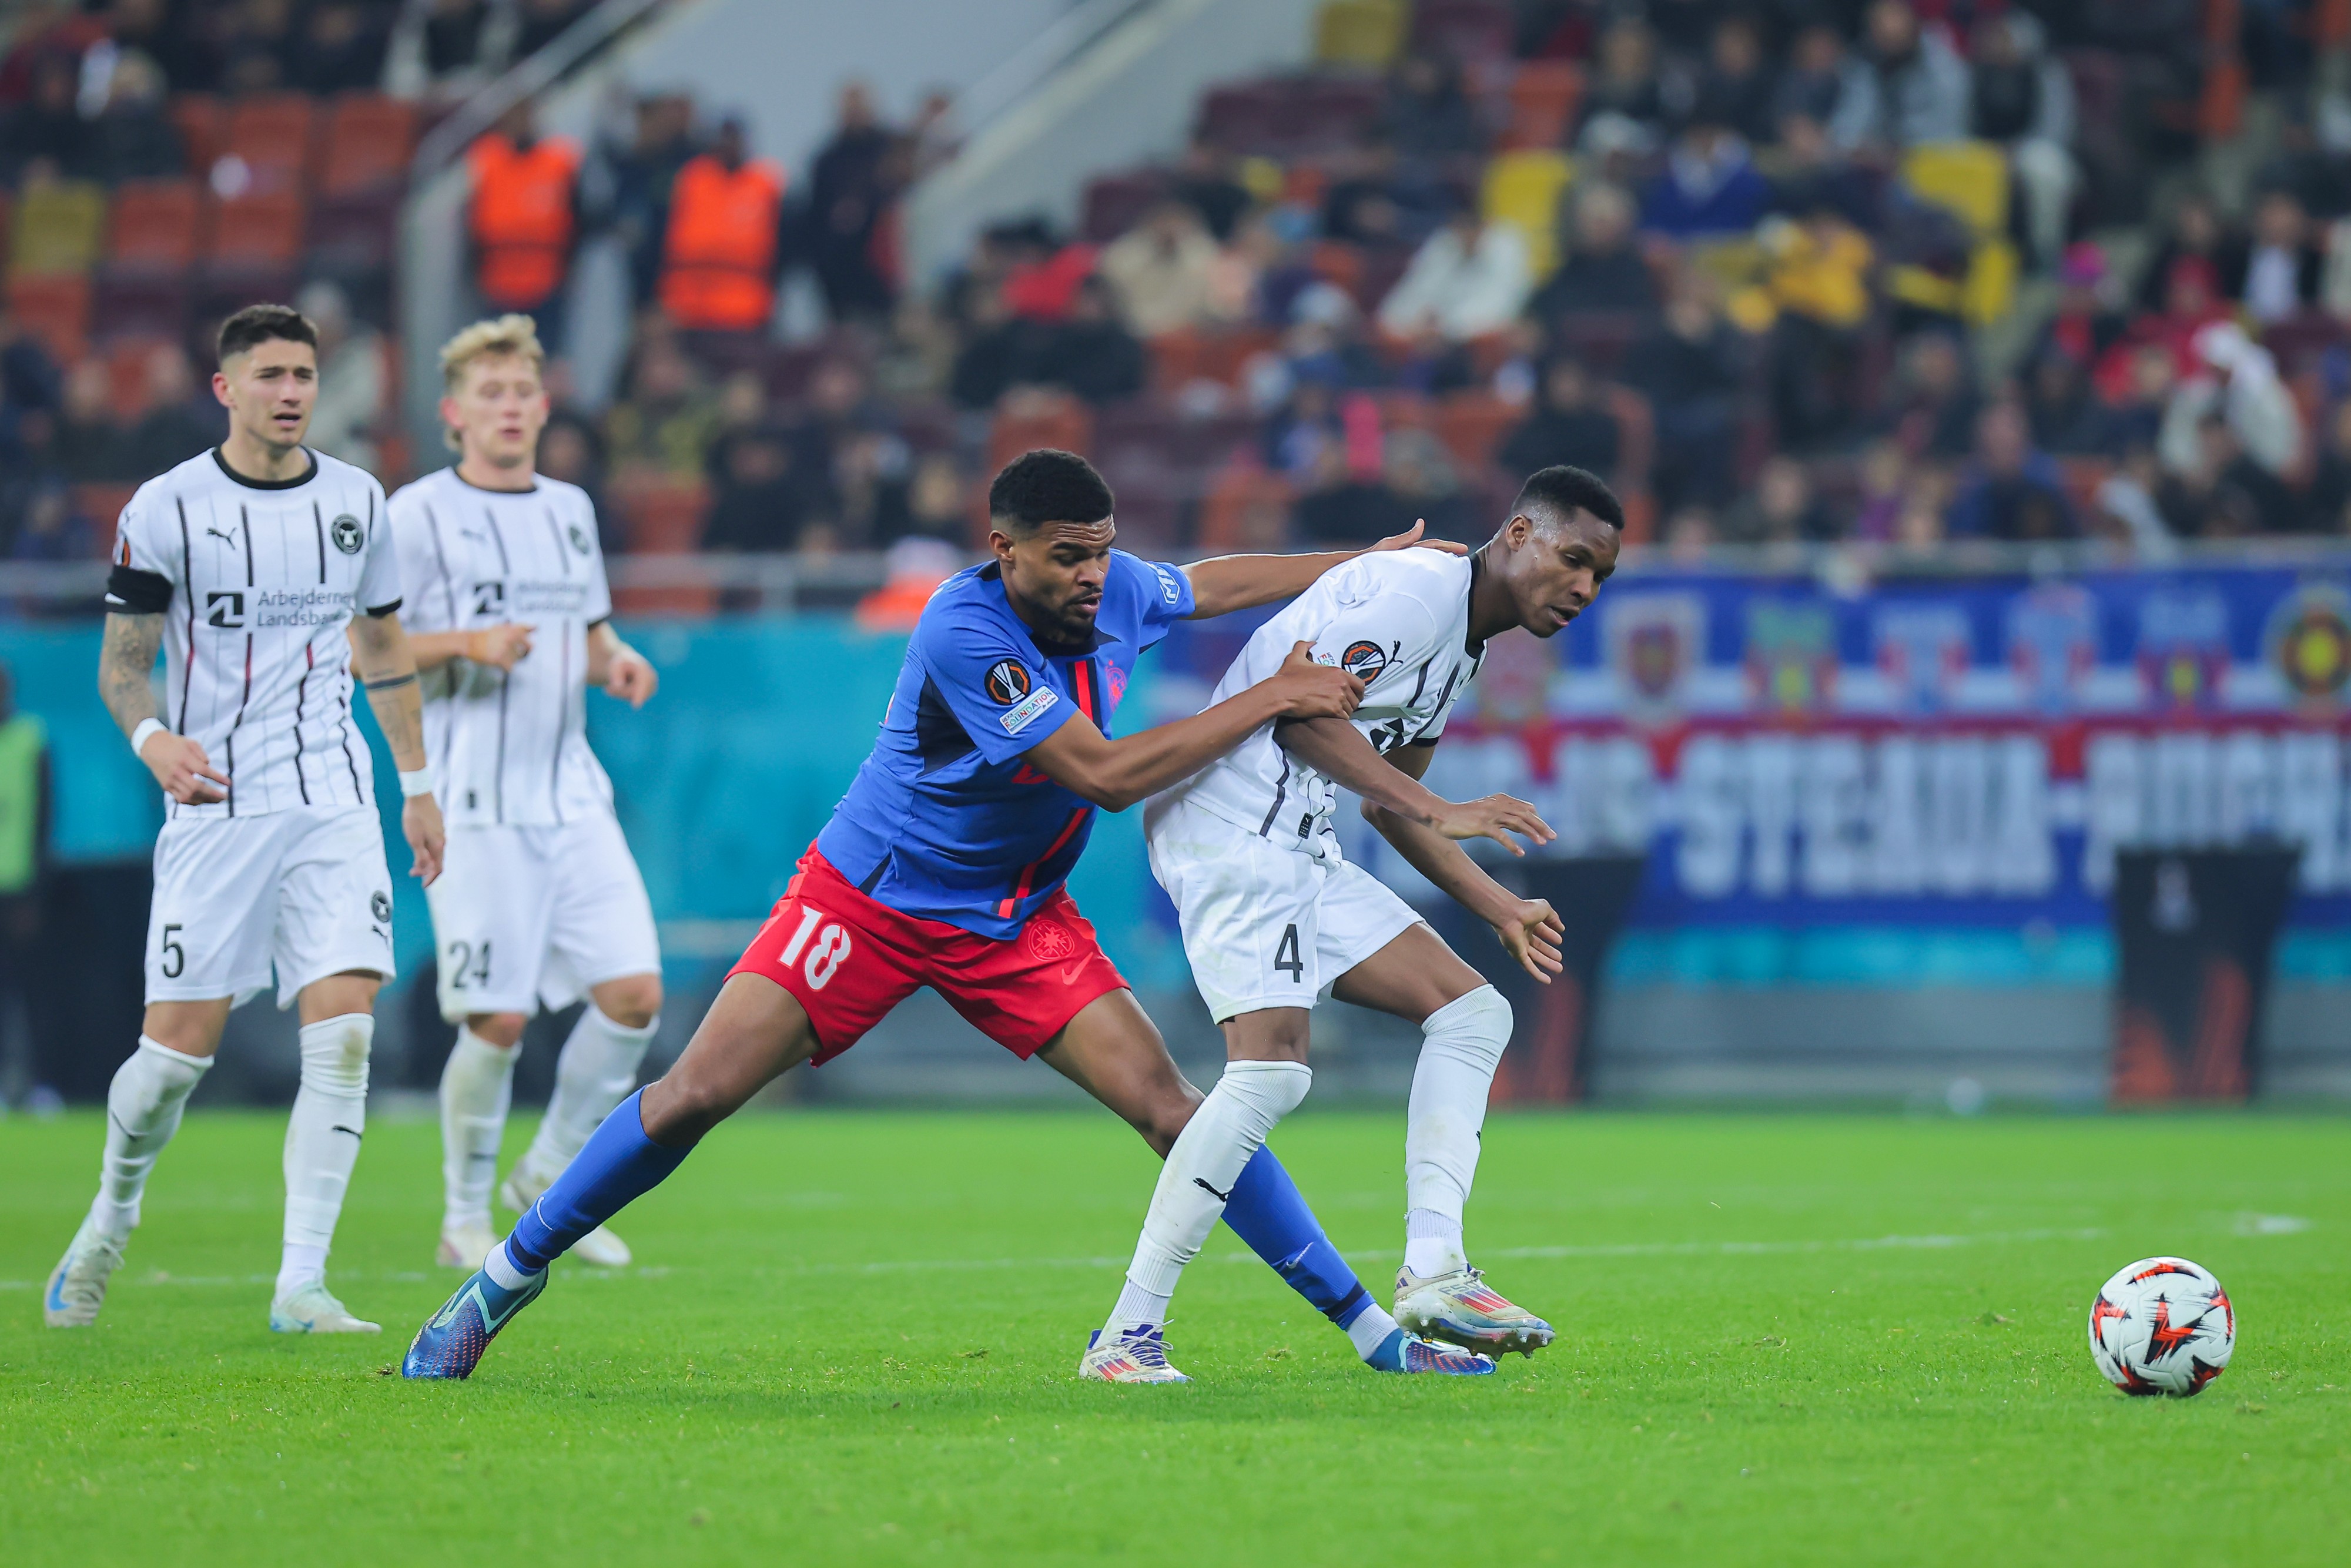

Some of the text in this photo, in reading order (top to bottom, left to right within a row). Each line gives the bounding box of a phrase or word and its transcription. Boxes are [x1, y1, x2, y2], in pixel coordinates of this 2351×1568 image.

[1004, 690, 1053, 729] FOUNDATION
[161, 923, 185, 979] 5
[449, 940, 493, 990] 24
[778, 904, 852, 990] 18
[1274, 923, 1304, 983] 4
